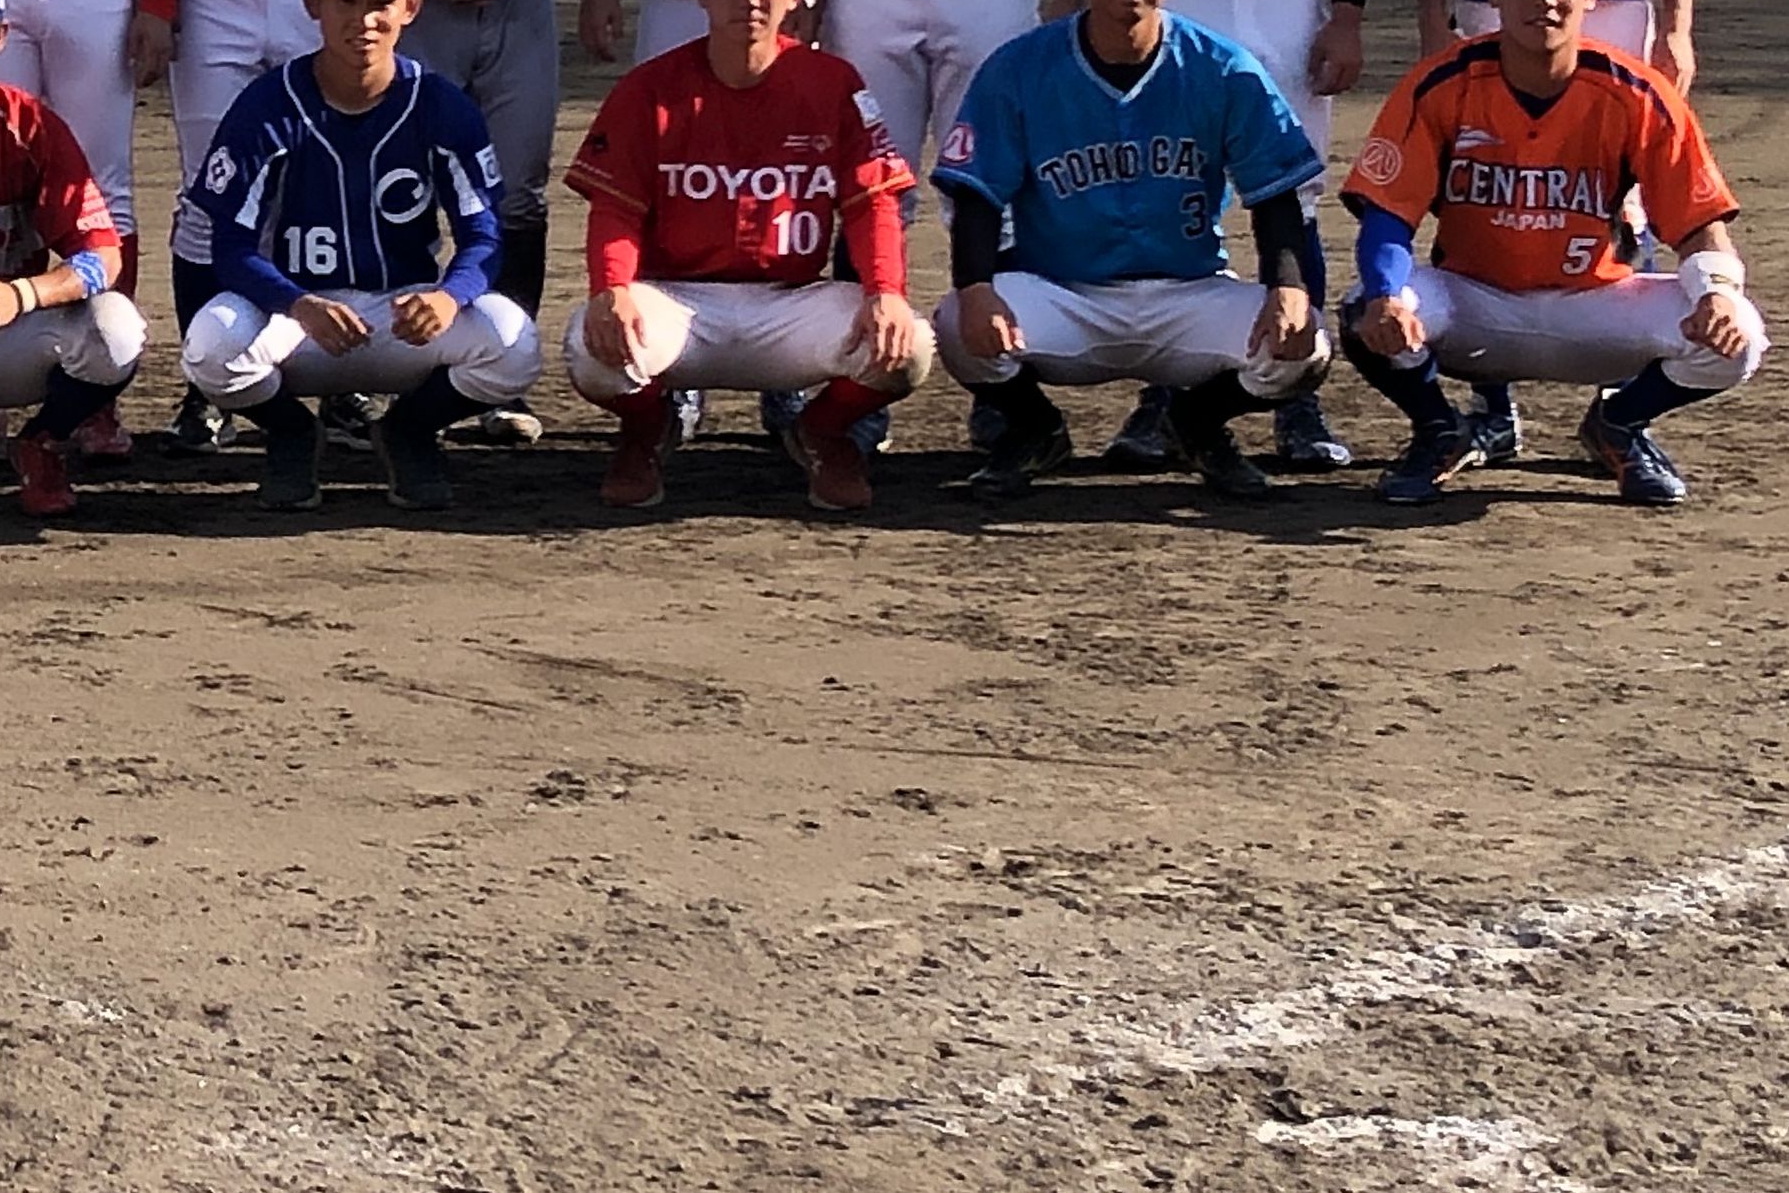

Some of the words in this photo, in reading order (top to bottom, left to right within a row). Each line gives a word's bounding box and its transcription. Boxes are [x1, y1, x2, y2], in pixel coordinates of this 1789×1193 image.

[657, 163, 836, 200] TOYOTA
[1038, 142, 1141, 199] TOHO
[1445, 159, 1613, 223] CENTRAL
[772, 210, 822, 255] 10
[1181, 192, 1209, 239] 3
[1490, 211, 1566, 232] JAPAN
[284, 226, 338, 275] 16
[1562, 237, 1597, 275] 5
